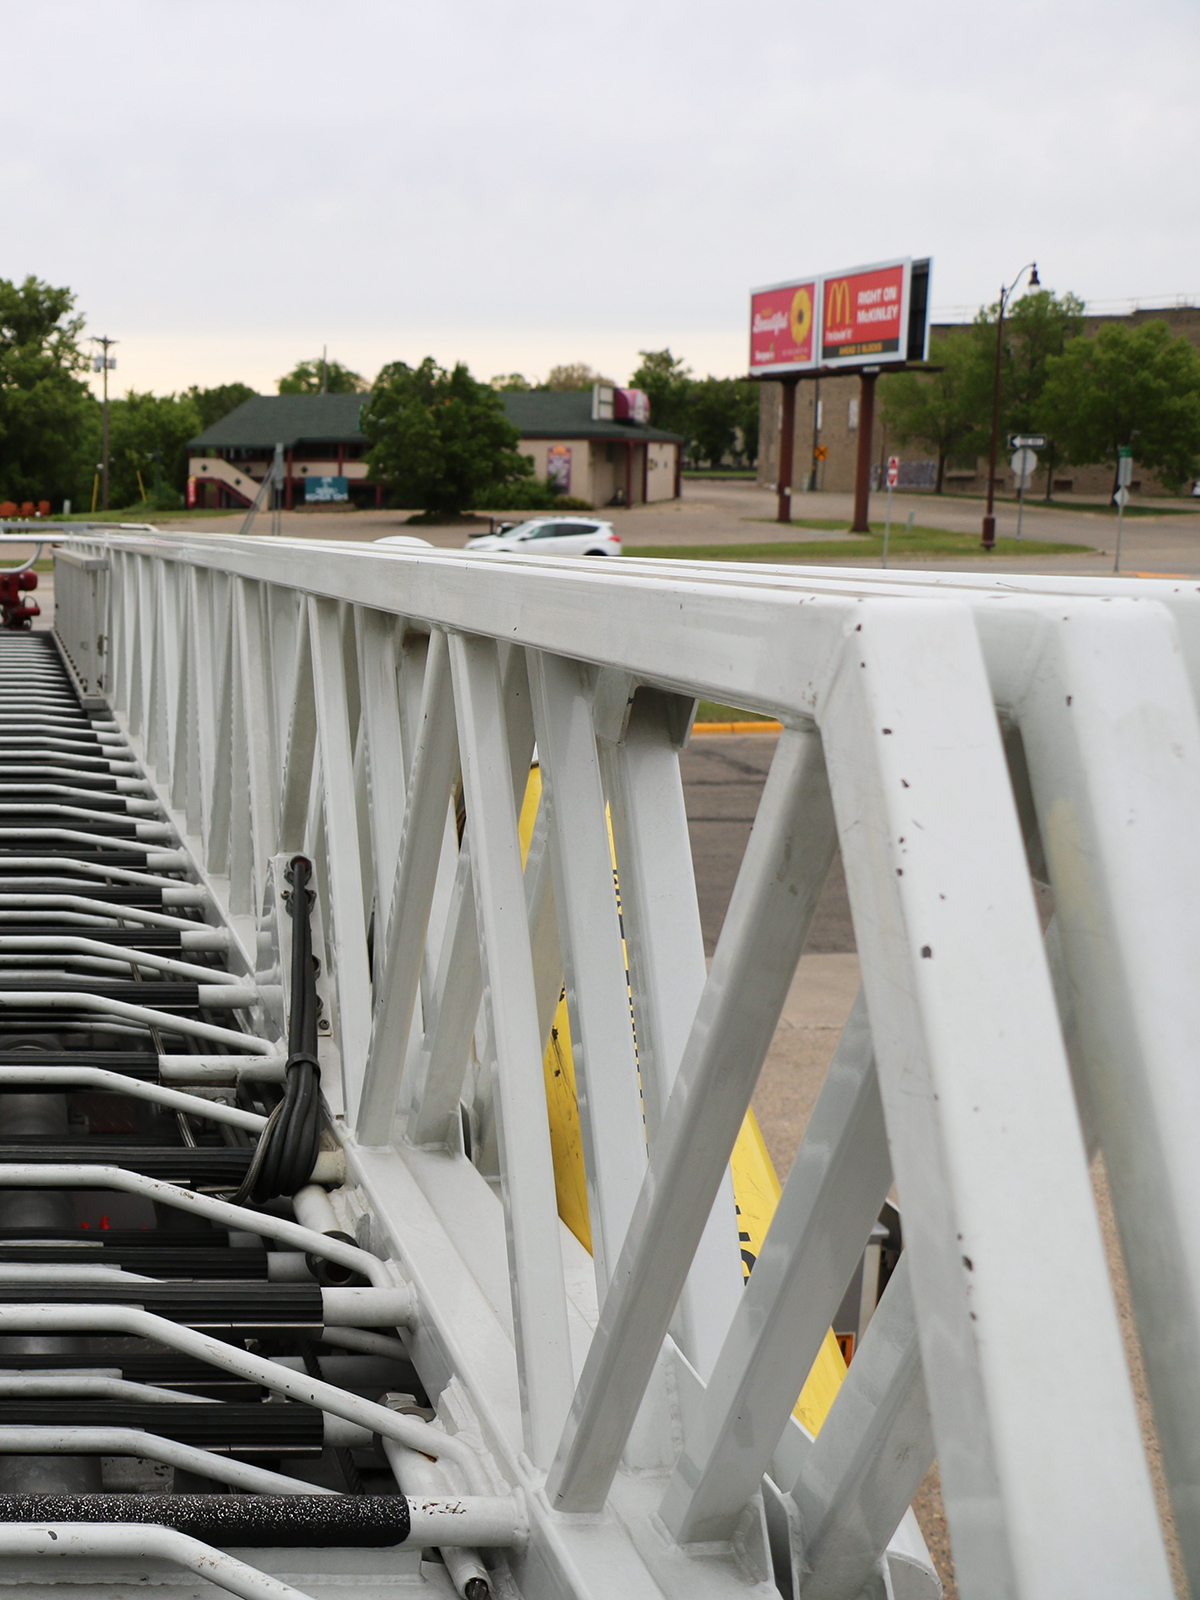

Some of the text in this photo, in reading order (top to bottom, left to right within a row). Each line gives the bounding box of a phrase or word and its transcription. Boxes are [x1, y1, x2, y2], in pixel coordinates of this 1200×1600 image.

[858, 286, 897, 305] RIGHT ON
[857, 304, 899, 324] McKINLEY
